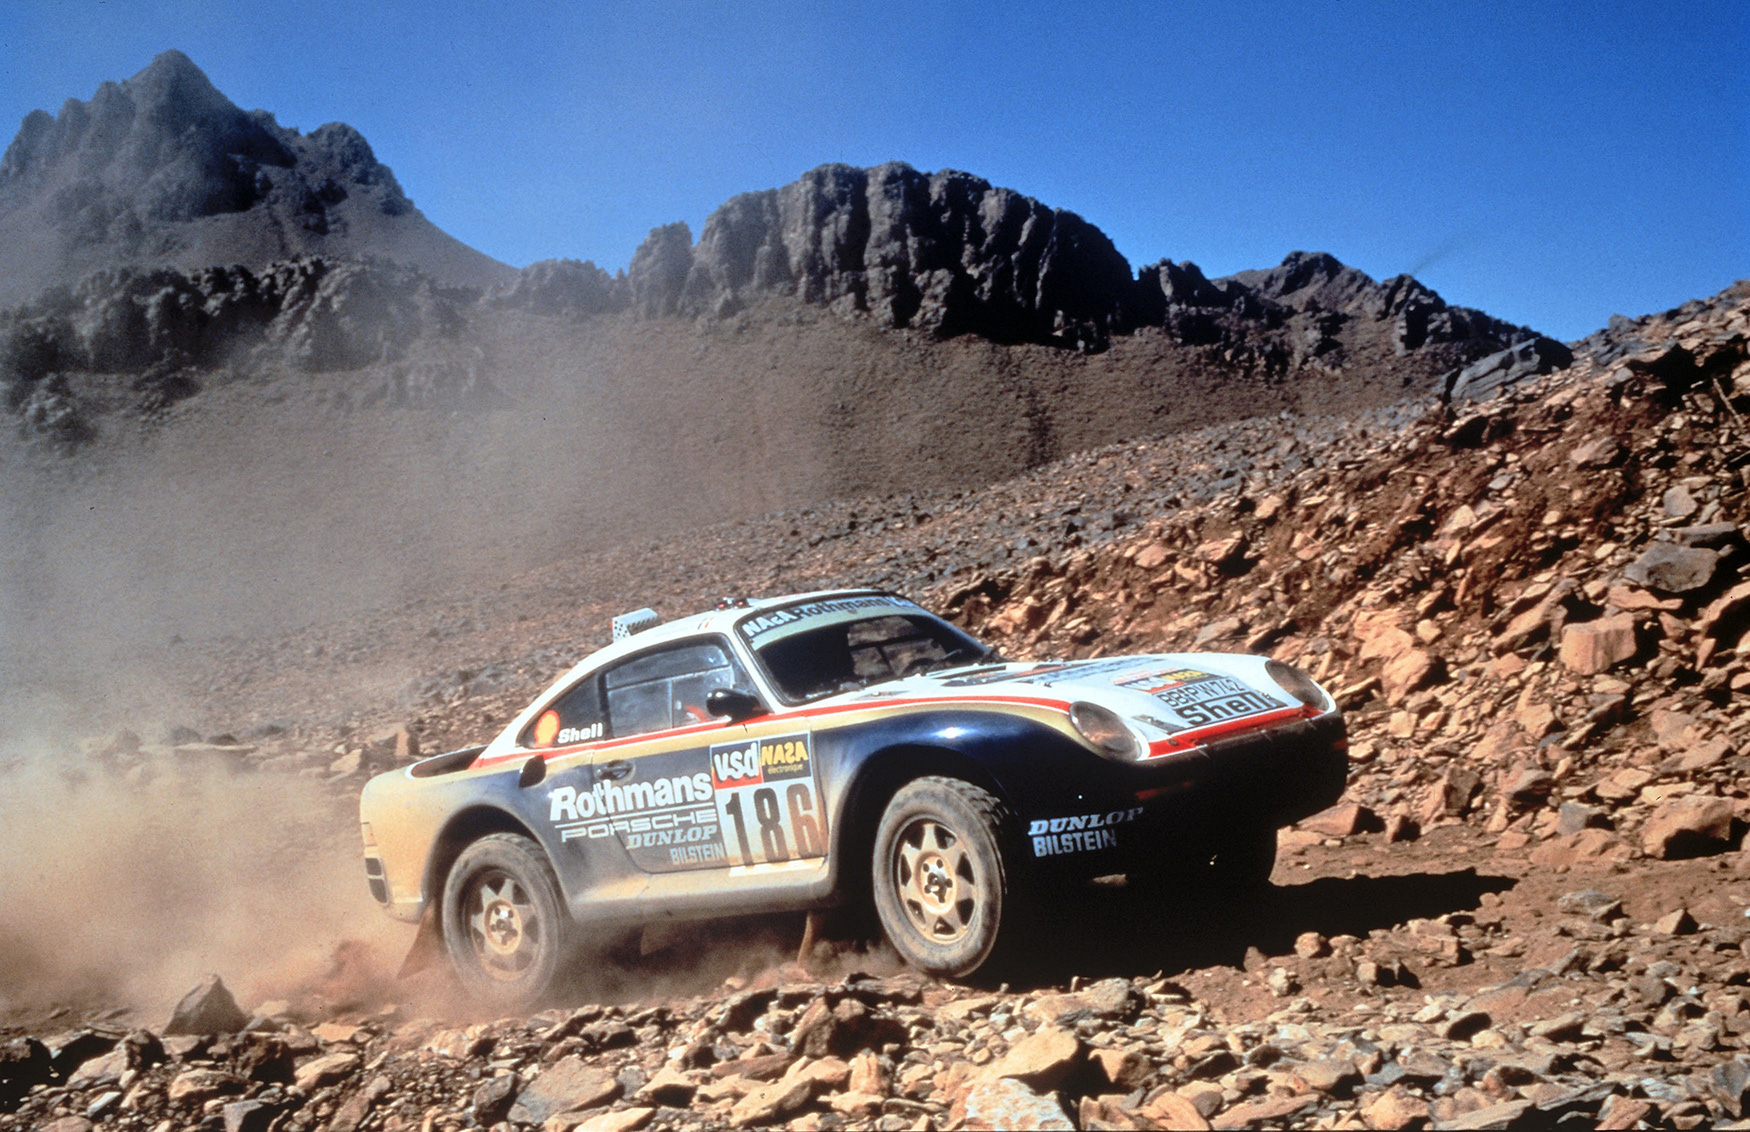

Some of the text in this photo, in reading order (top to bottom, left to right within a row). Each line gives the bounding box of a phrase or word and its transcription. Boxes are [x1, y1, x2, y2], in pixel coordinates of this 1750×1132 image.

[1176, 691, 1272, 726] Shell
[557, 722, 603, 744] Shell
[549, 773, 714, 821] Rothmans
[561, 808, 718, 843] PORSCHE
[725, 782, 823, 866] 186
[1027, 807, 1144, 836] DUNLOP
[626, 825, 718, 850] DUNLOP
[1032, 828, 1117, 858] BILSTEIN
[669, 842, 726, 865] BILSTEIN
